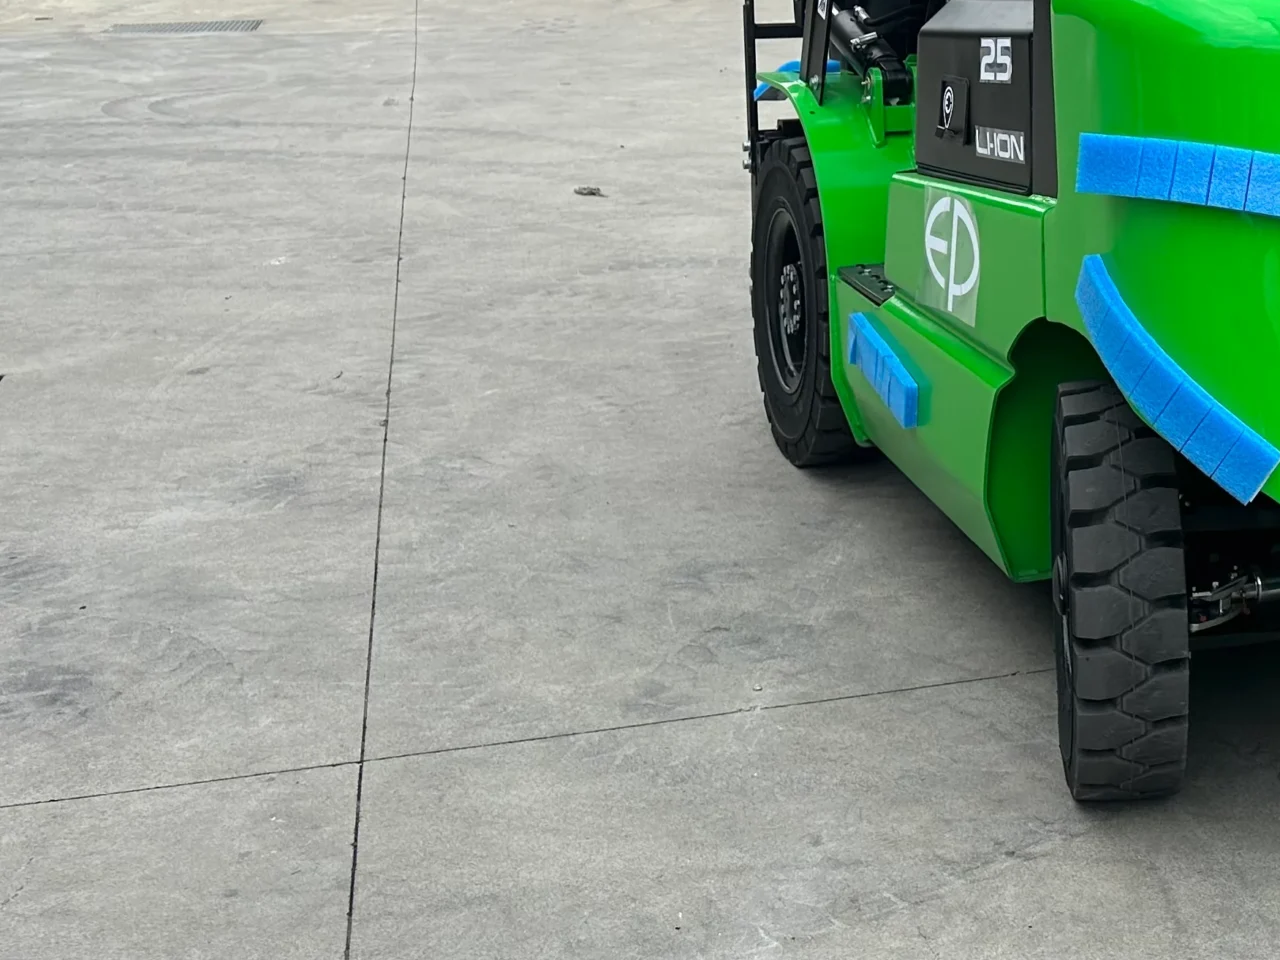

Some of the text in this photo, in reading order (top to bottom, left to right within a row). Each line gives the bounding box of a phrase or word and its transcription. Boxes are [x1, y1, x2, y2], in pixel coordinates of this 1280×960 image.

[980, 38, 1012, 80] 25
[976, 129, 1024, 161] LI-ION
[925, 196, 980, 312] EP
